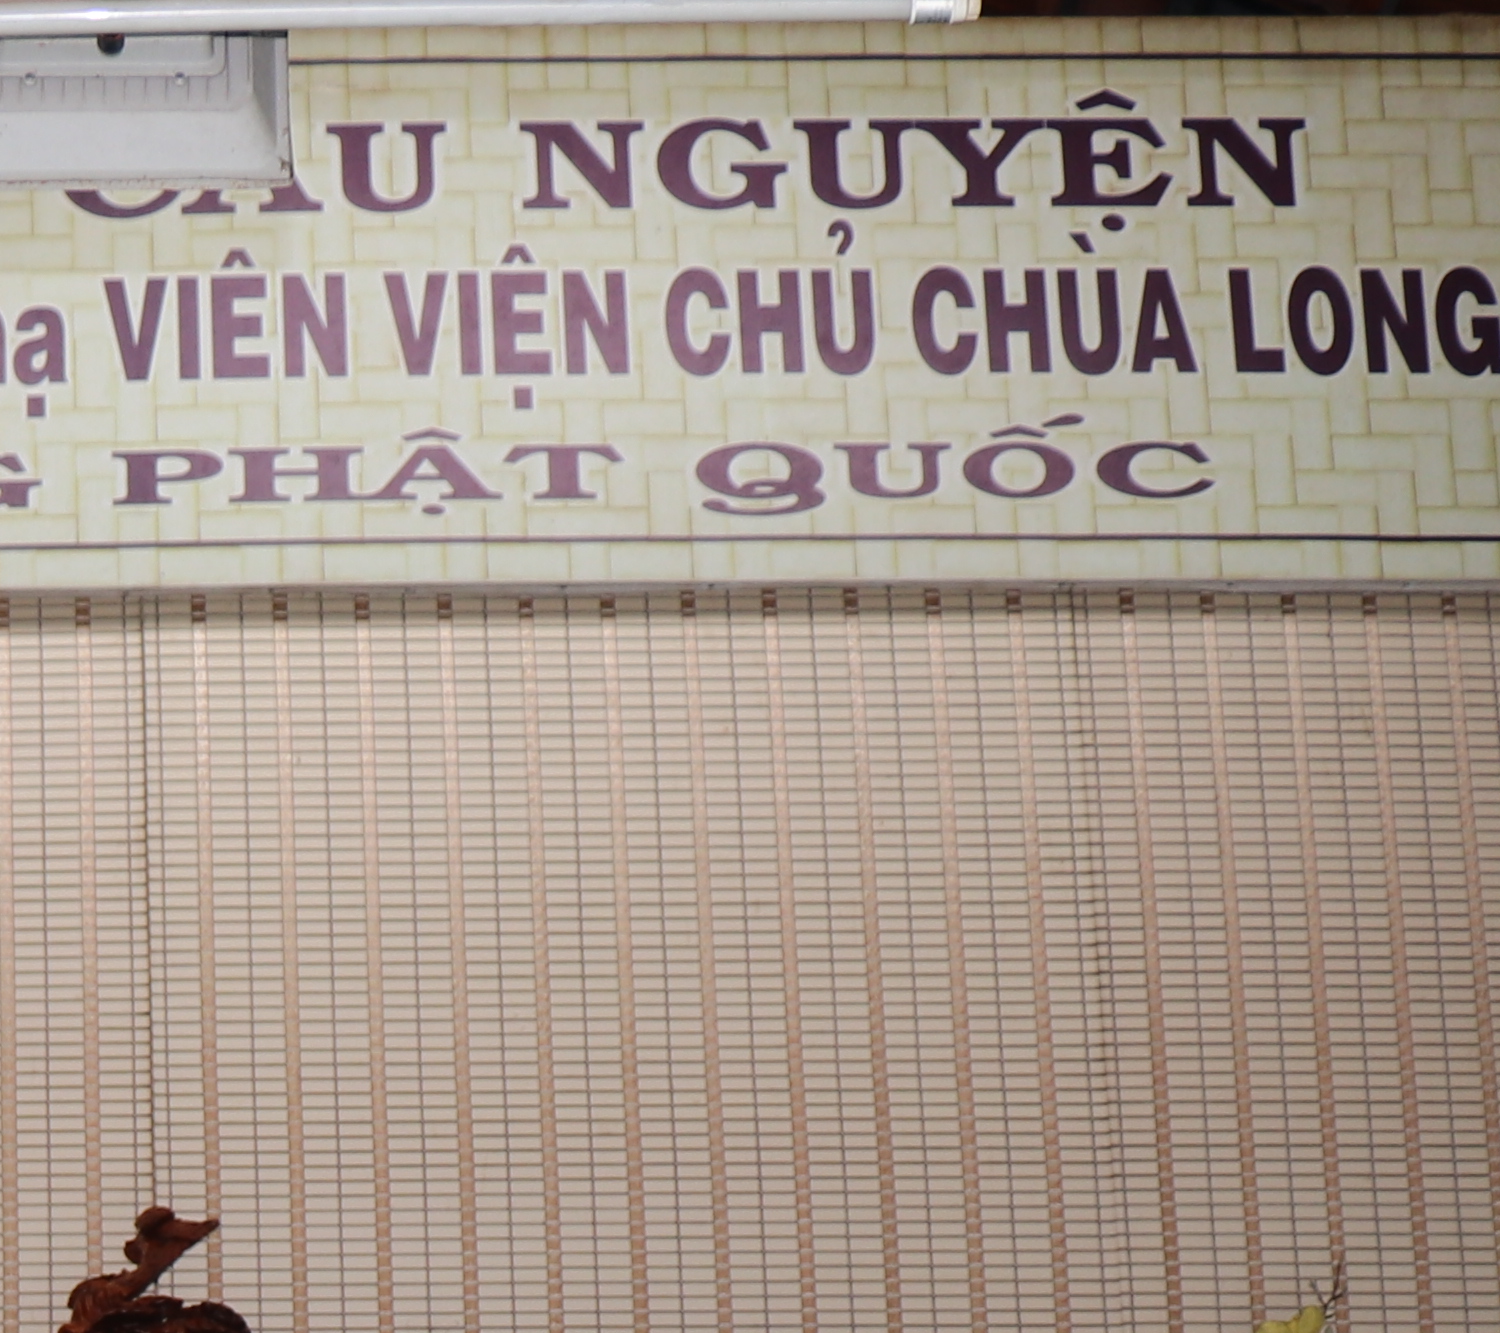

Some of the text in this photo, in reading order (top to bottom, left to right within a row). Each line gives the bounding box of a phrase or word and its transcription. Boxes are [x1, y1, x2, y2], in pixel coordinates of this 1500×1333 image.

[519, 87, 1296, 231] NGUYỆN
[103, 249, 348, 381] VIÊN
[384, 244, 630, 409] VIỆN
[665, 219, 875, 376] CHỦ
[912, 232, 1198, 374] CHÙA
[111, 427, 624, 516] PHẬT
[696, 413, 1214, 515] QUỐC
